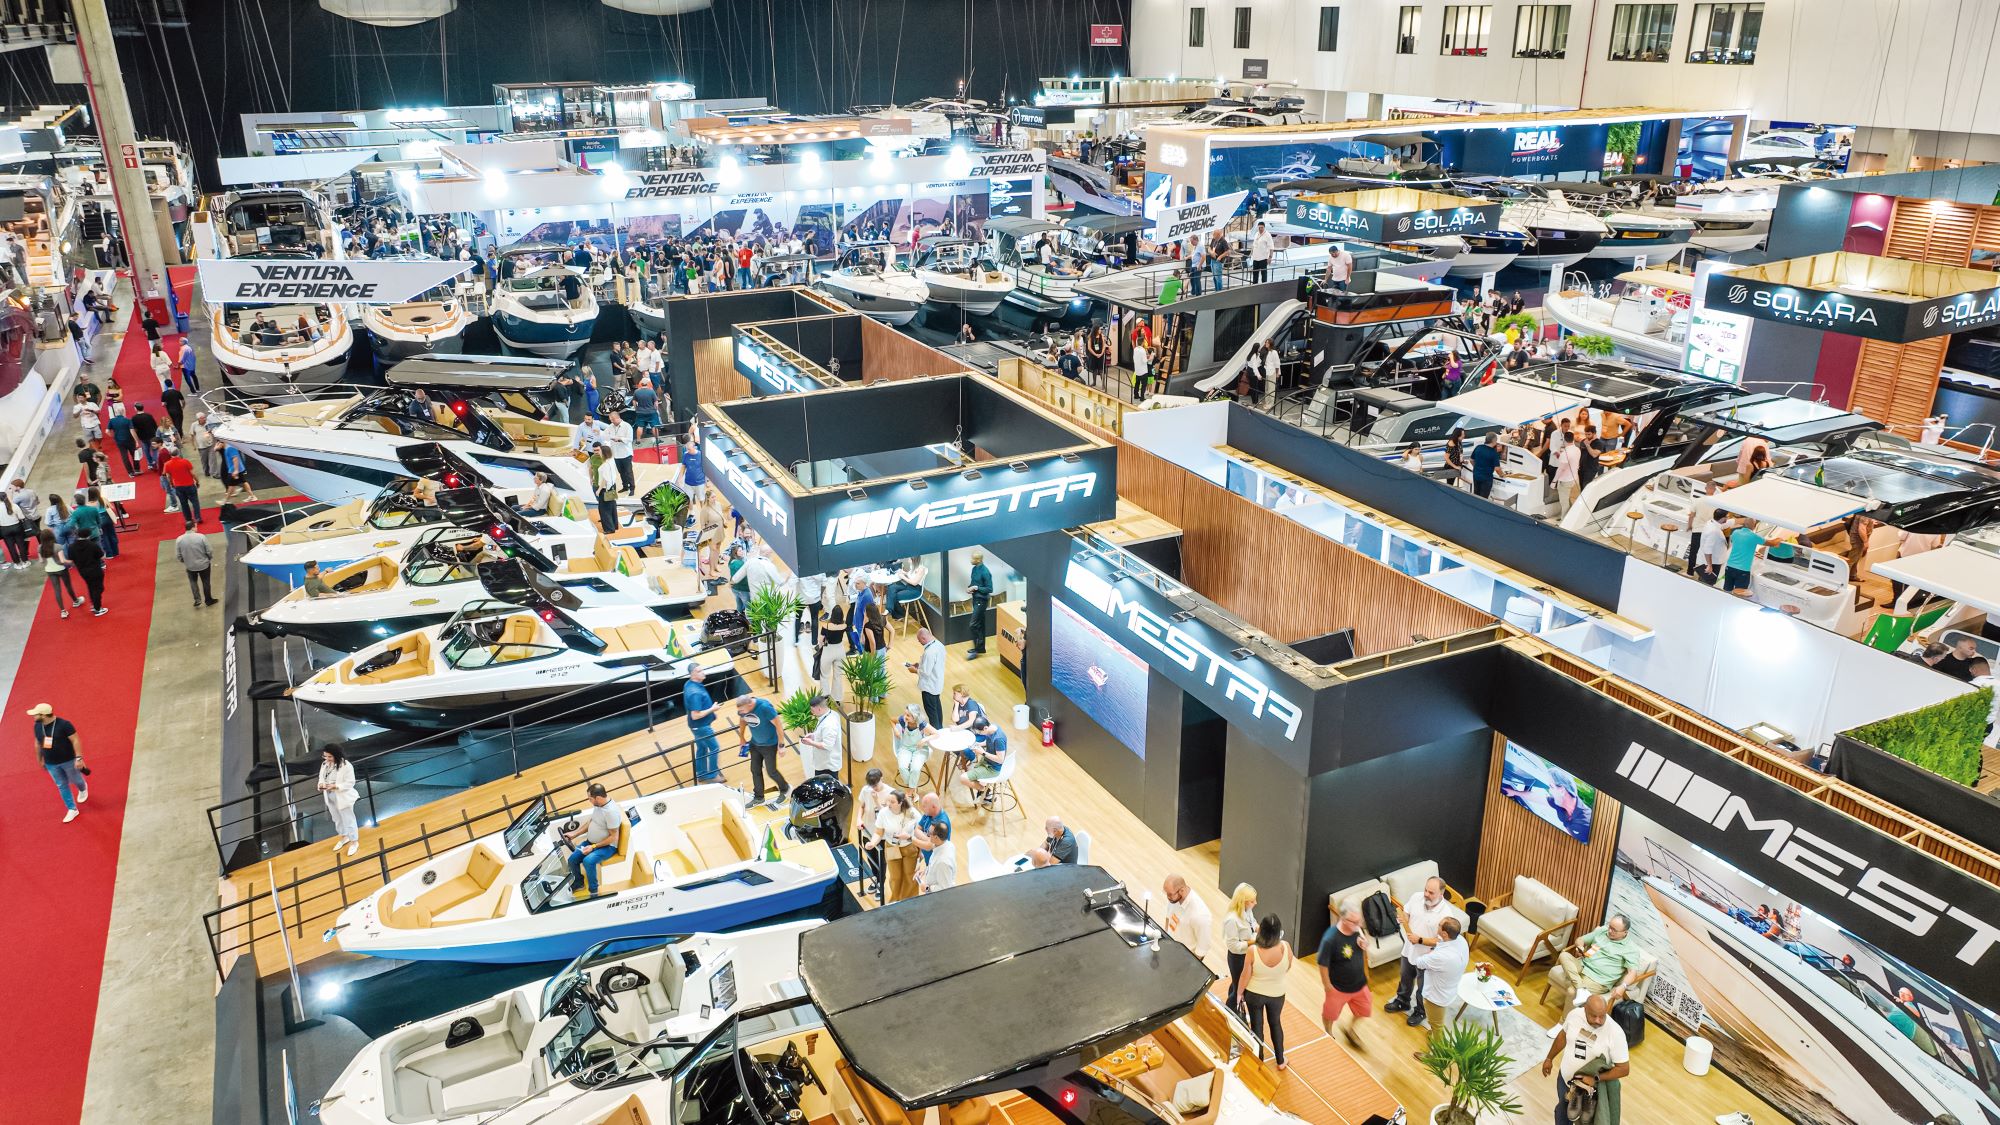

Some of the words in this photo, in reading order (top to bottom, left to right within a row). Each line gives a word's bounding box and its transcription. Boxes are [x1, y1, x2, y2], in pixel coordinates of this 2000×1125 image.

[1021, 115, 1043, 123] TRITON
[1513, 131, 1559, 151] REAL
[980, 153, 1034, 165] VENTURA
[1511, 155, 1558, 163] POWERBOATS
[969, 163, 1046, 177] EXPERIENCE
[638, 172, 705, 185] VENTURA
[625, 183, 720, 199] EXPERIENCE
[730, 197, 773, 205] EXPERIENCE
[1177, 203, 1211, 221] VENTURA
[1308, 209, 1369, 231] SOLARA
[1168, 215, 1218, 238] EXPERIENCE
[1319, 222, 1350, 232] YACHTS
[1414, 212, 1486, 231] SOLARA
[1427, 226, 1463, 234] YACHTS
[250, 265, 354, 281] VENTURA
[235, 283, 378, 298] EXPERIENCE
[1753, 290, 1878, 327] SOLARA
[1941, 295, 2000, 323] SOLA
[1774, 311, 1834, 327] YACHTS
[1955, 314, 1997, 328] YACHTS
[888, 472, 1097, 534] MESTRA
[1106, 587, 1303, 741] MESTRA
[801, 797, 834, 818] MERCURY
[627, 902, 648, 911] 190
